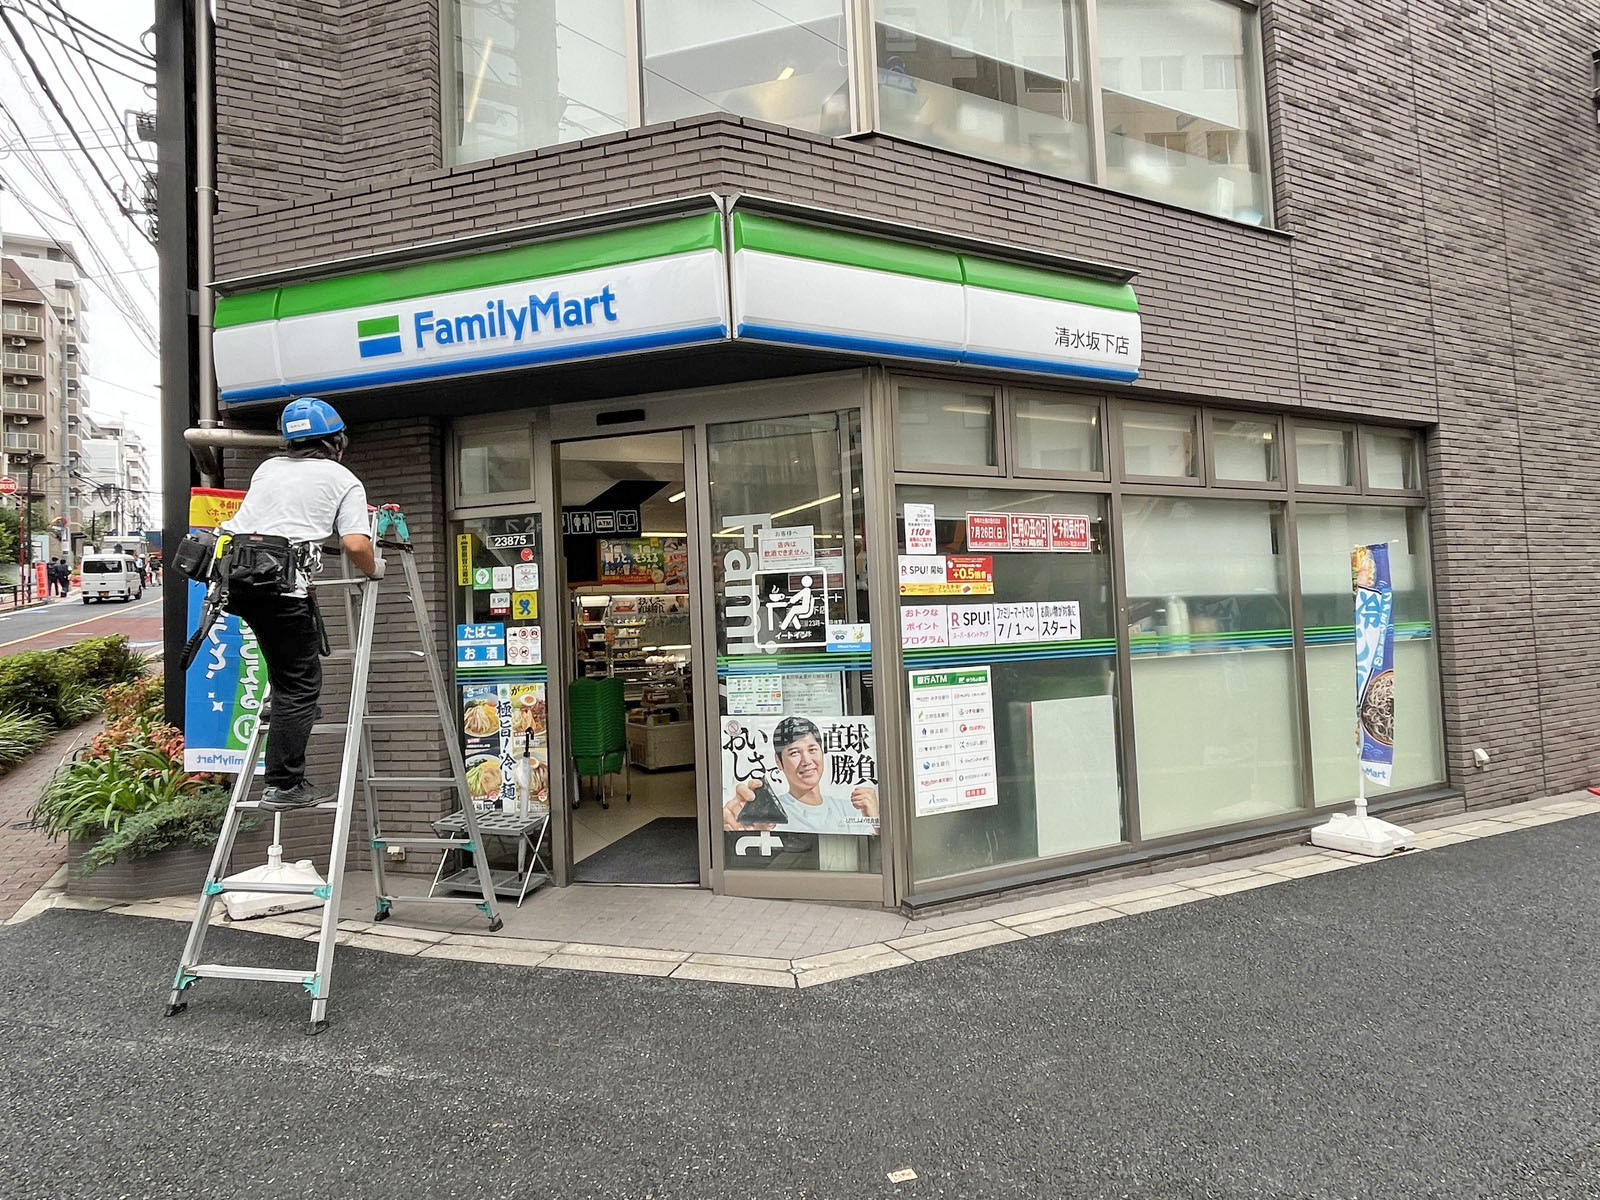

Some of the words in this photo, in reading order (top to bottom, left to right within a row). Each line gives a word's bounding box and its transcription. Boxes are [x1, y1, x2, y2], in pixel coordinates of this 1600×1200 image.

[414, 284, 618, 348] FamilyMart
[1054, 326, 1129, 355] 清水坂下店
[1053, 519, 1086, 539] ご予約受付中
[494, 535, 527, 547] 23875
[909, 565, 929, 575] SPU!
[905, 608, 939, 617] おトクな
[963, 610, 990, 626] SPU!
[464, 625, 496, 639] たばこ
[906, 622, 939, 631] ポイント
[1042, 619, 1077, 636] スタート
[902, 635, 945, 645] プログラム
[464, 646, 498, 660] お酒
[917, 674, 948, 685] 銀行ATM
[822, 723, 870, 754] 直球
[830, 754, 879, 786] 勝負
